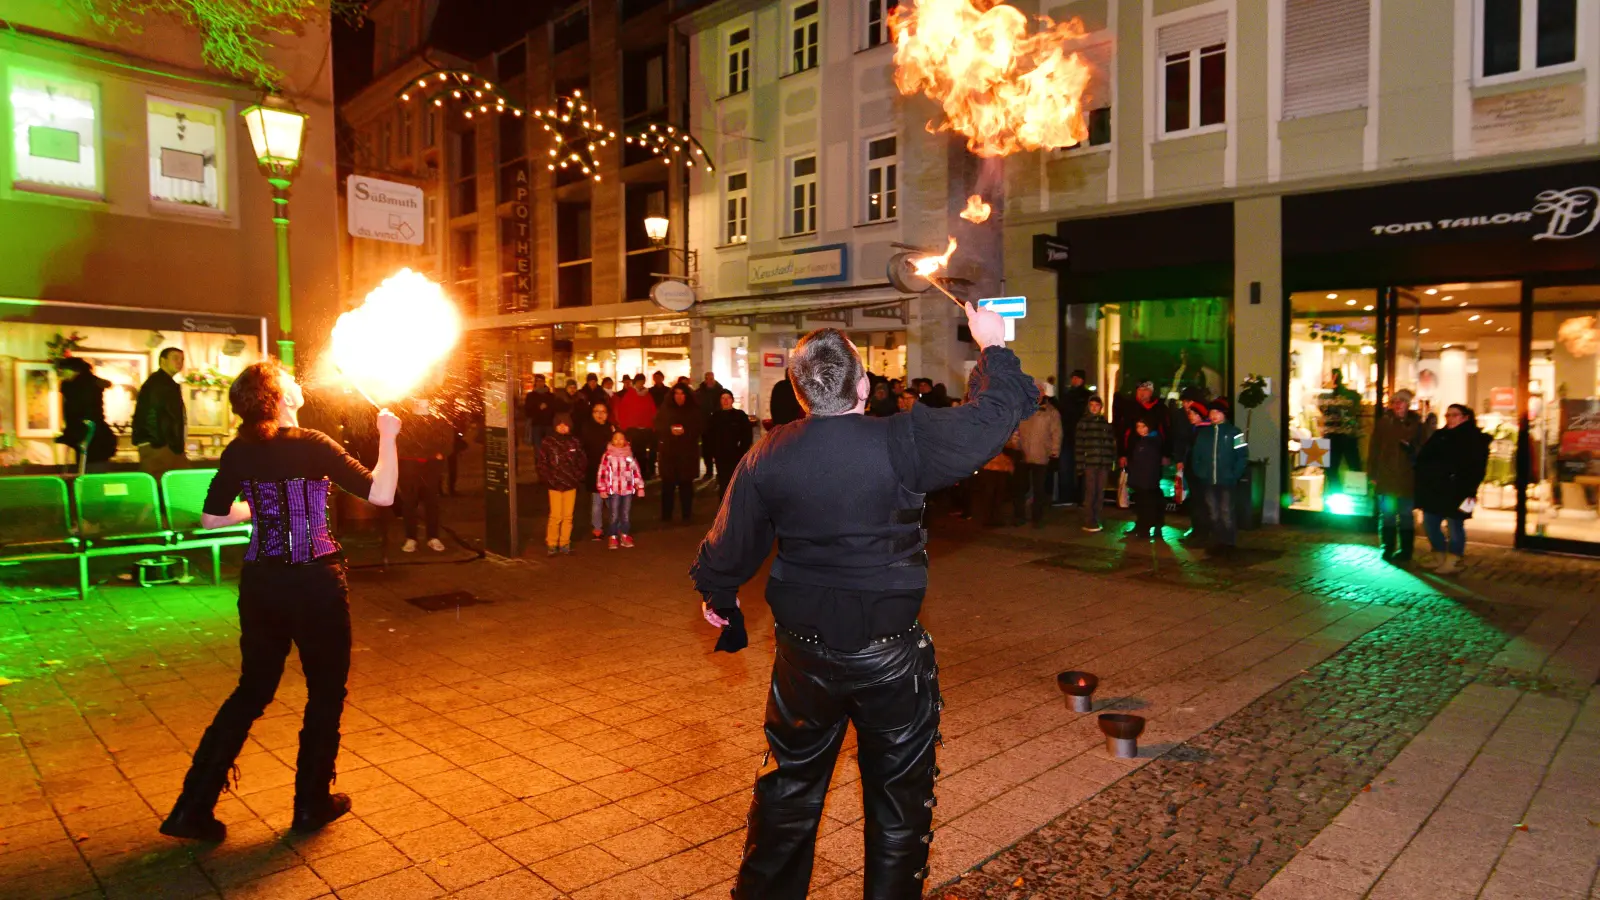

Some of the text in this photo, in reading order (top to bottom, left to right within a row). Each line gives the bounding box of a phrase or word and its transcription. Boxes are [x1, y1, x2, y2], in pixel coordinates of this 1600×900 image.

[355, 182, 418, 209] Süßmuth
[1370, 211, 1534, 235] TOM TAILOR
[516, 169, 529, 308] APOTHEKE
